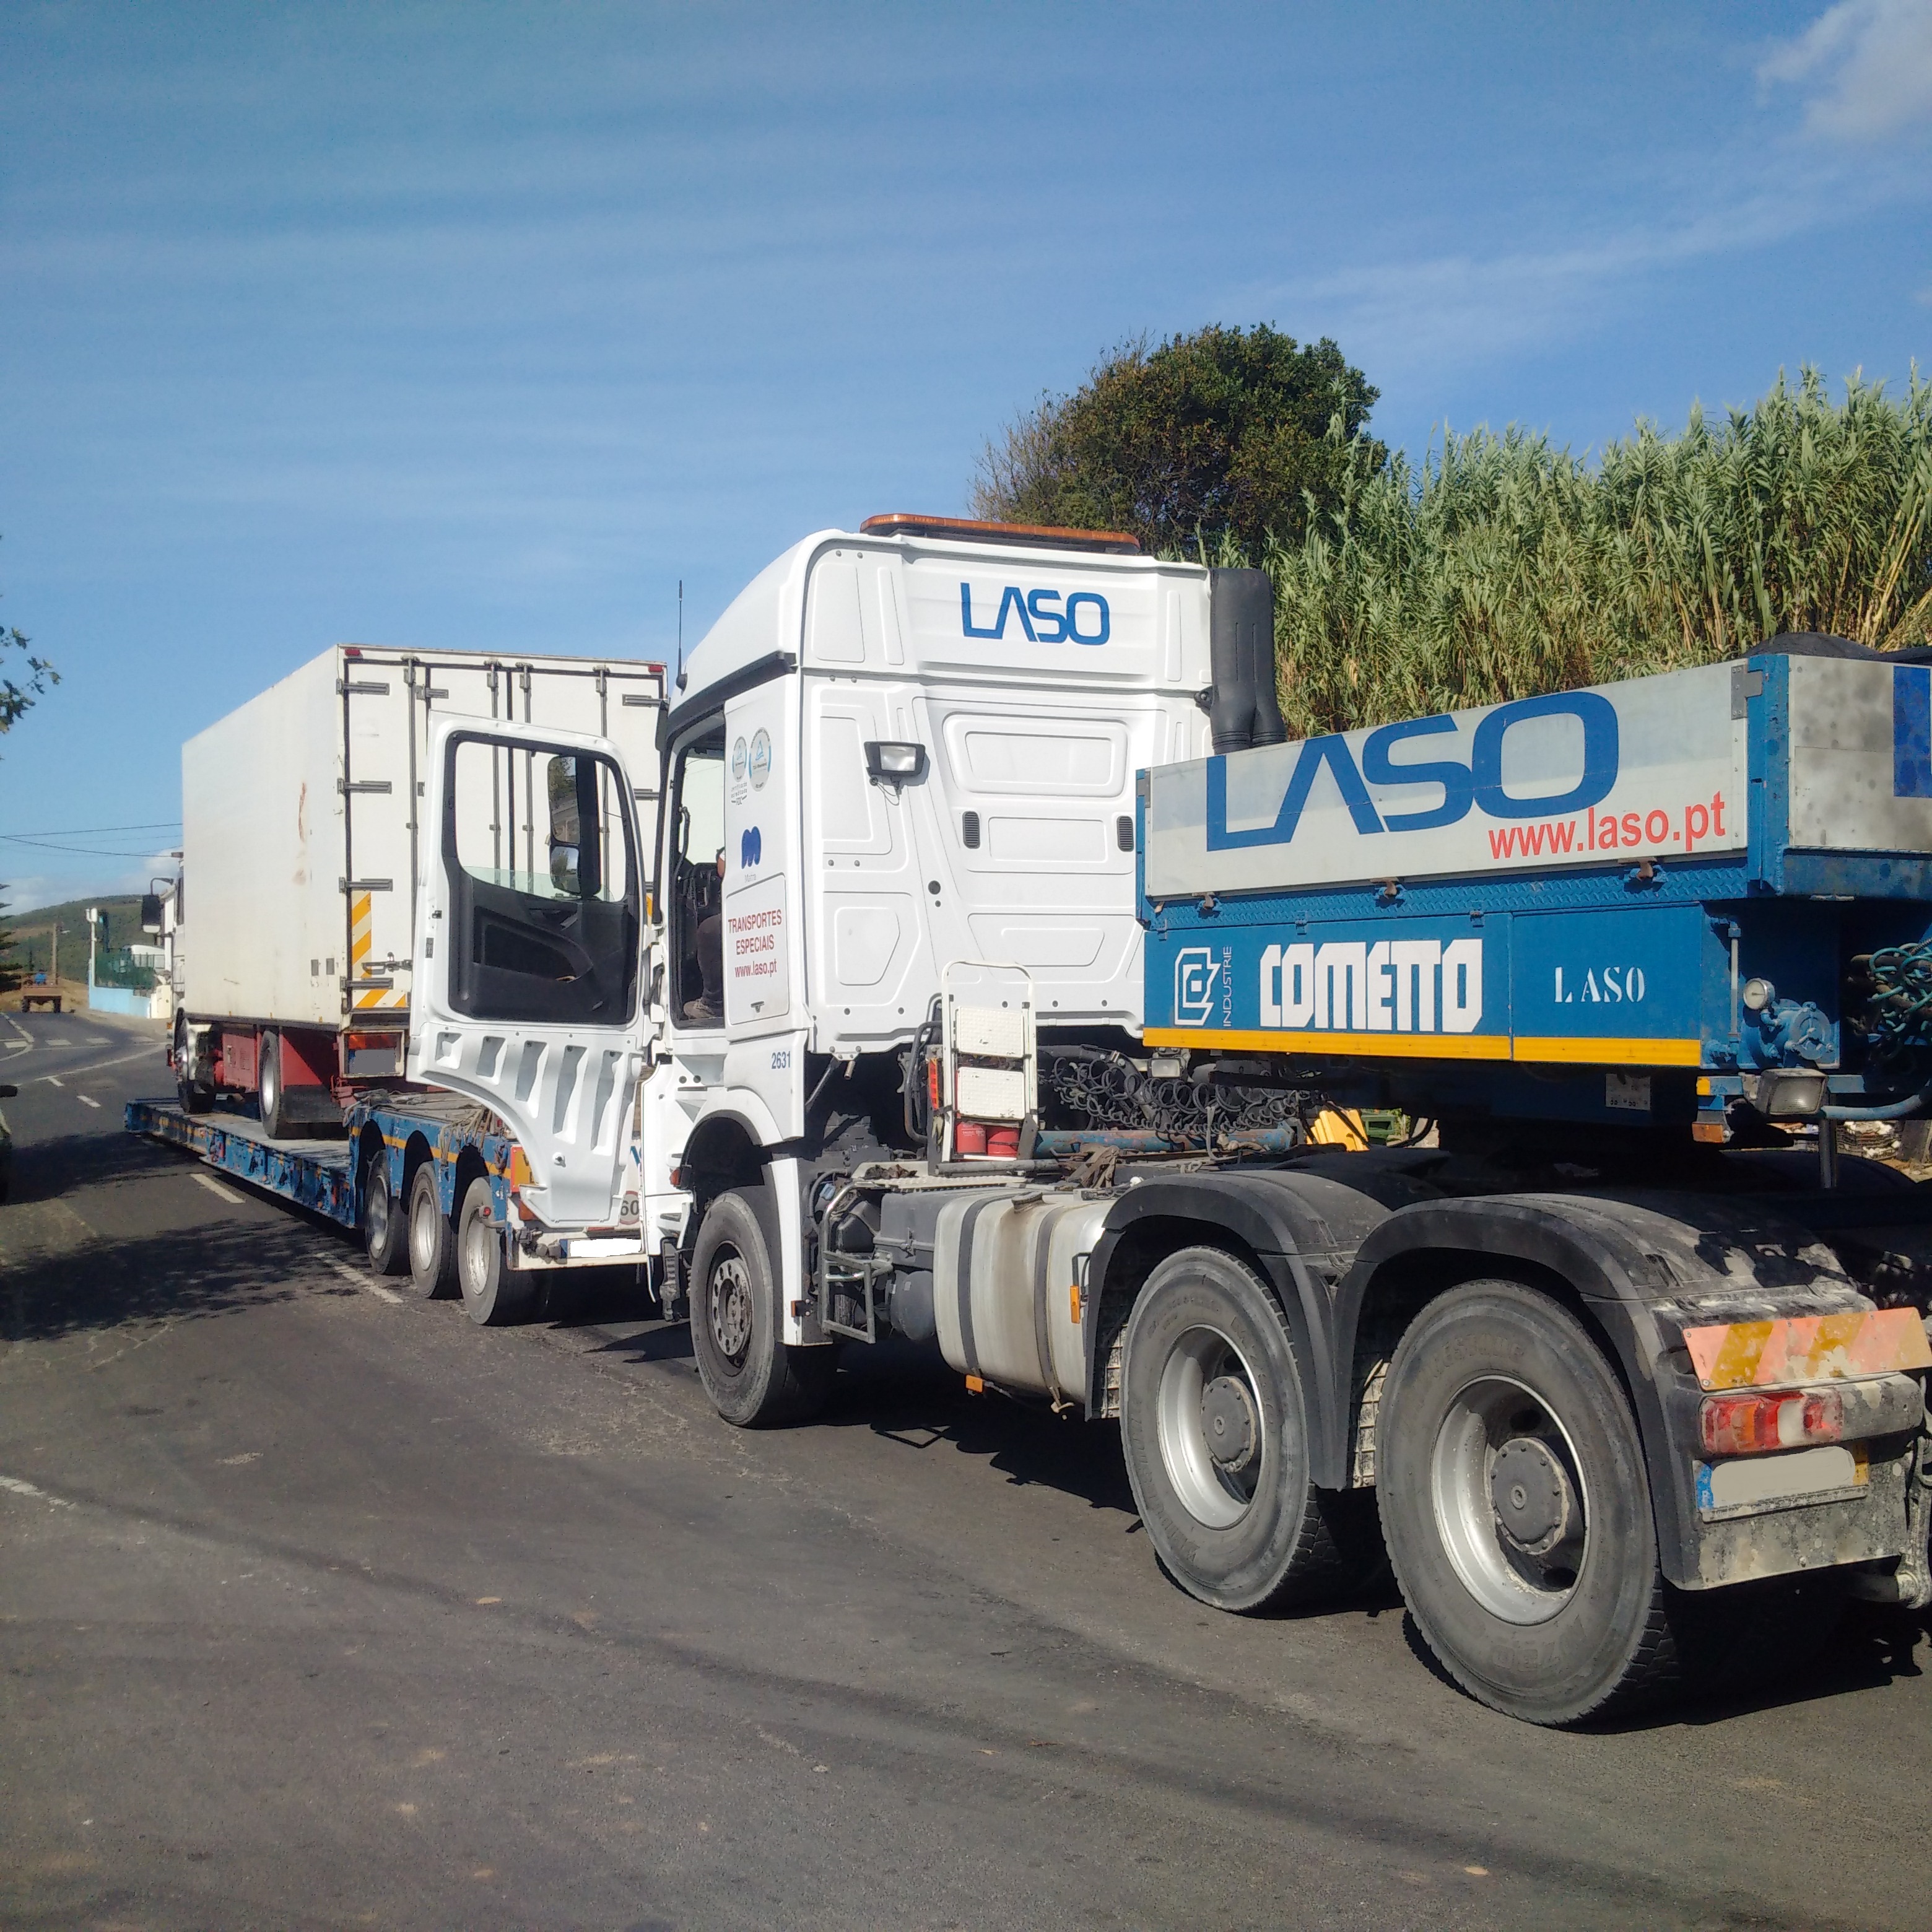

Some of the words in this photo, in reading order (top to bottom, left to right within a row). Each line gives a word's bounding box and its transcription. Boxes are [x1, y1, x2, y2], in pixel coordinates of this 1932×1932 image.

[960, 582, 1110, 645] LASO
[1206, 691, 1619, 852] LASO
[1489, 791, 1726, 859] www.laso.pt
[728, 908, 782, 934] TRANSPORTES
[736, 934, 775, 955] ESPECIAIS
[734, 959, 777, 978] www.laso.pt
[1223, 946, 1232, 1027] INDUSTRIE
[1260, 938, 1482, 1033] COMETTO
[1555, 966, 1645, 1003] LASO
[771, 1050, 791, 1069] 2631
[620, 1199, 639, 1216] 60
